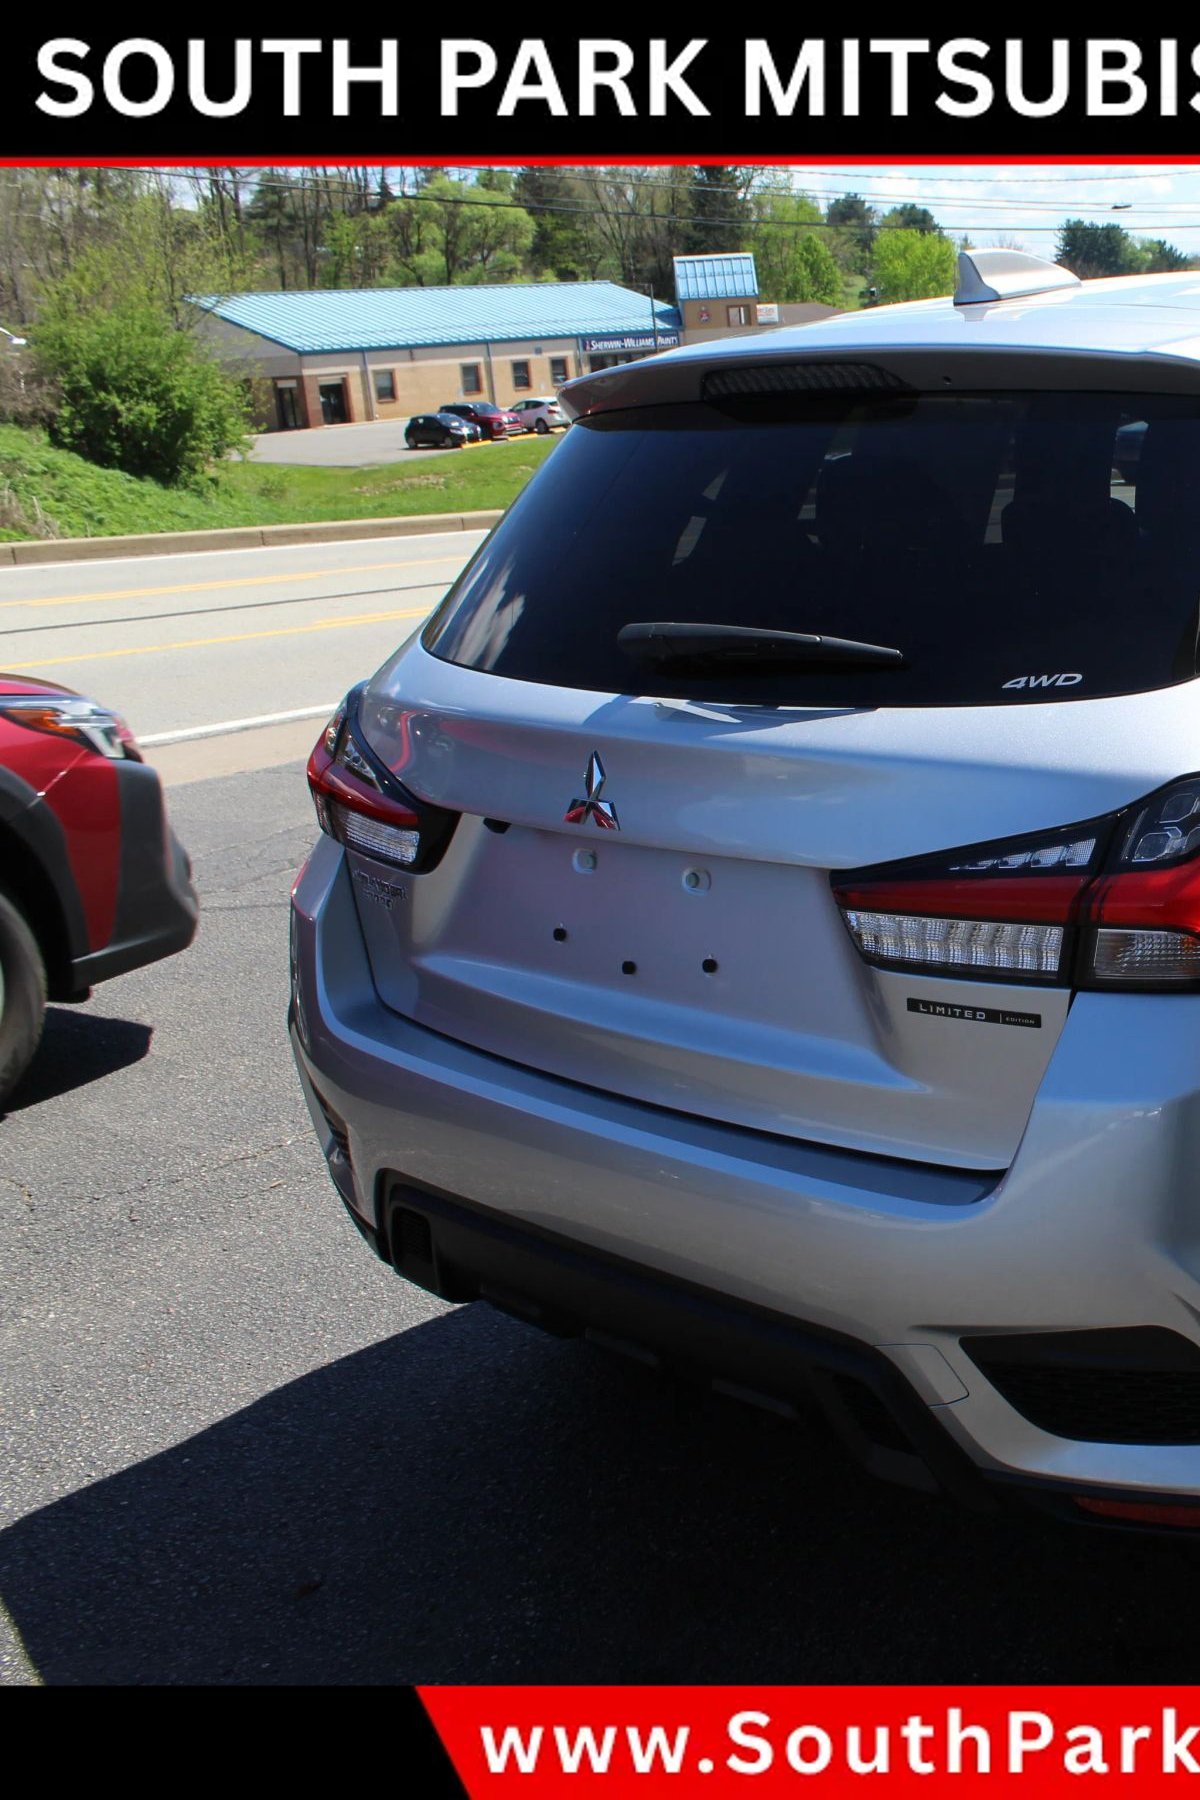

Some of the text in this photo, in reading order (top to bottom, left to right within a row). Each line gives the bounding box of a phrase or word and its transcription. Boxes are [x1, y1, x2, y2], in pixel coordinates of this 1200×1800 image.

[1001, 673, 1083, 689] 4WD
[919, 1003, 1035, 1025] LIMITED EDITION
